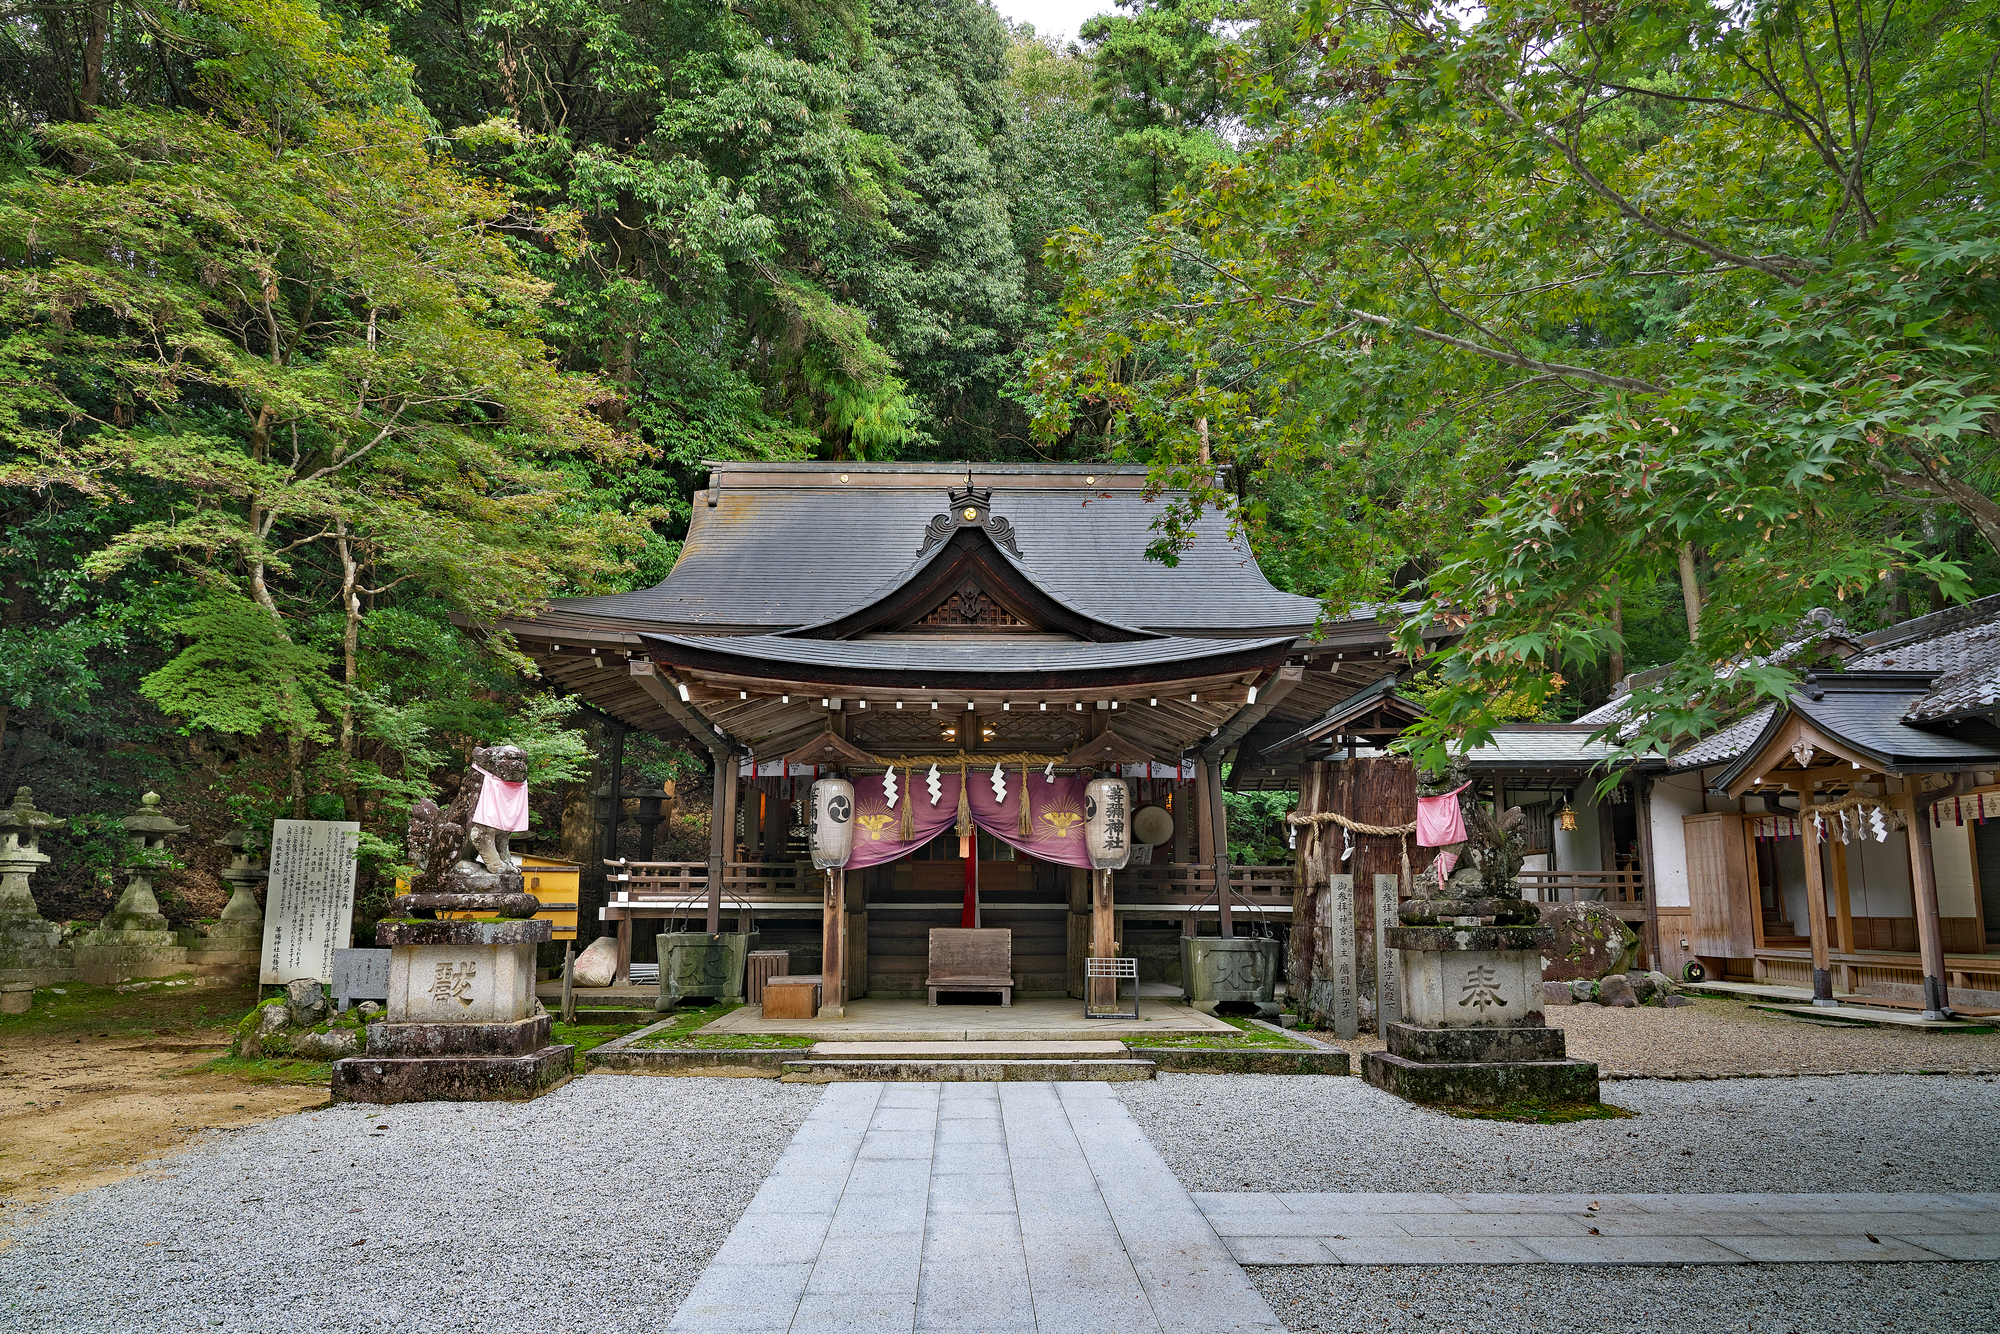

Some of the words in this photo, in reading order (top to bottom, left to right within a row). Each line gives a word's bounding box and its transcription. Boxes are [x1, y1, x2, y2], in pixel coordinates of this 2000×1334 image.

[1103, 784, 1125, 851] 等彌神社
[1458, 964, 1508, 1014] 奉
